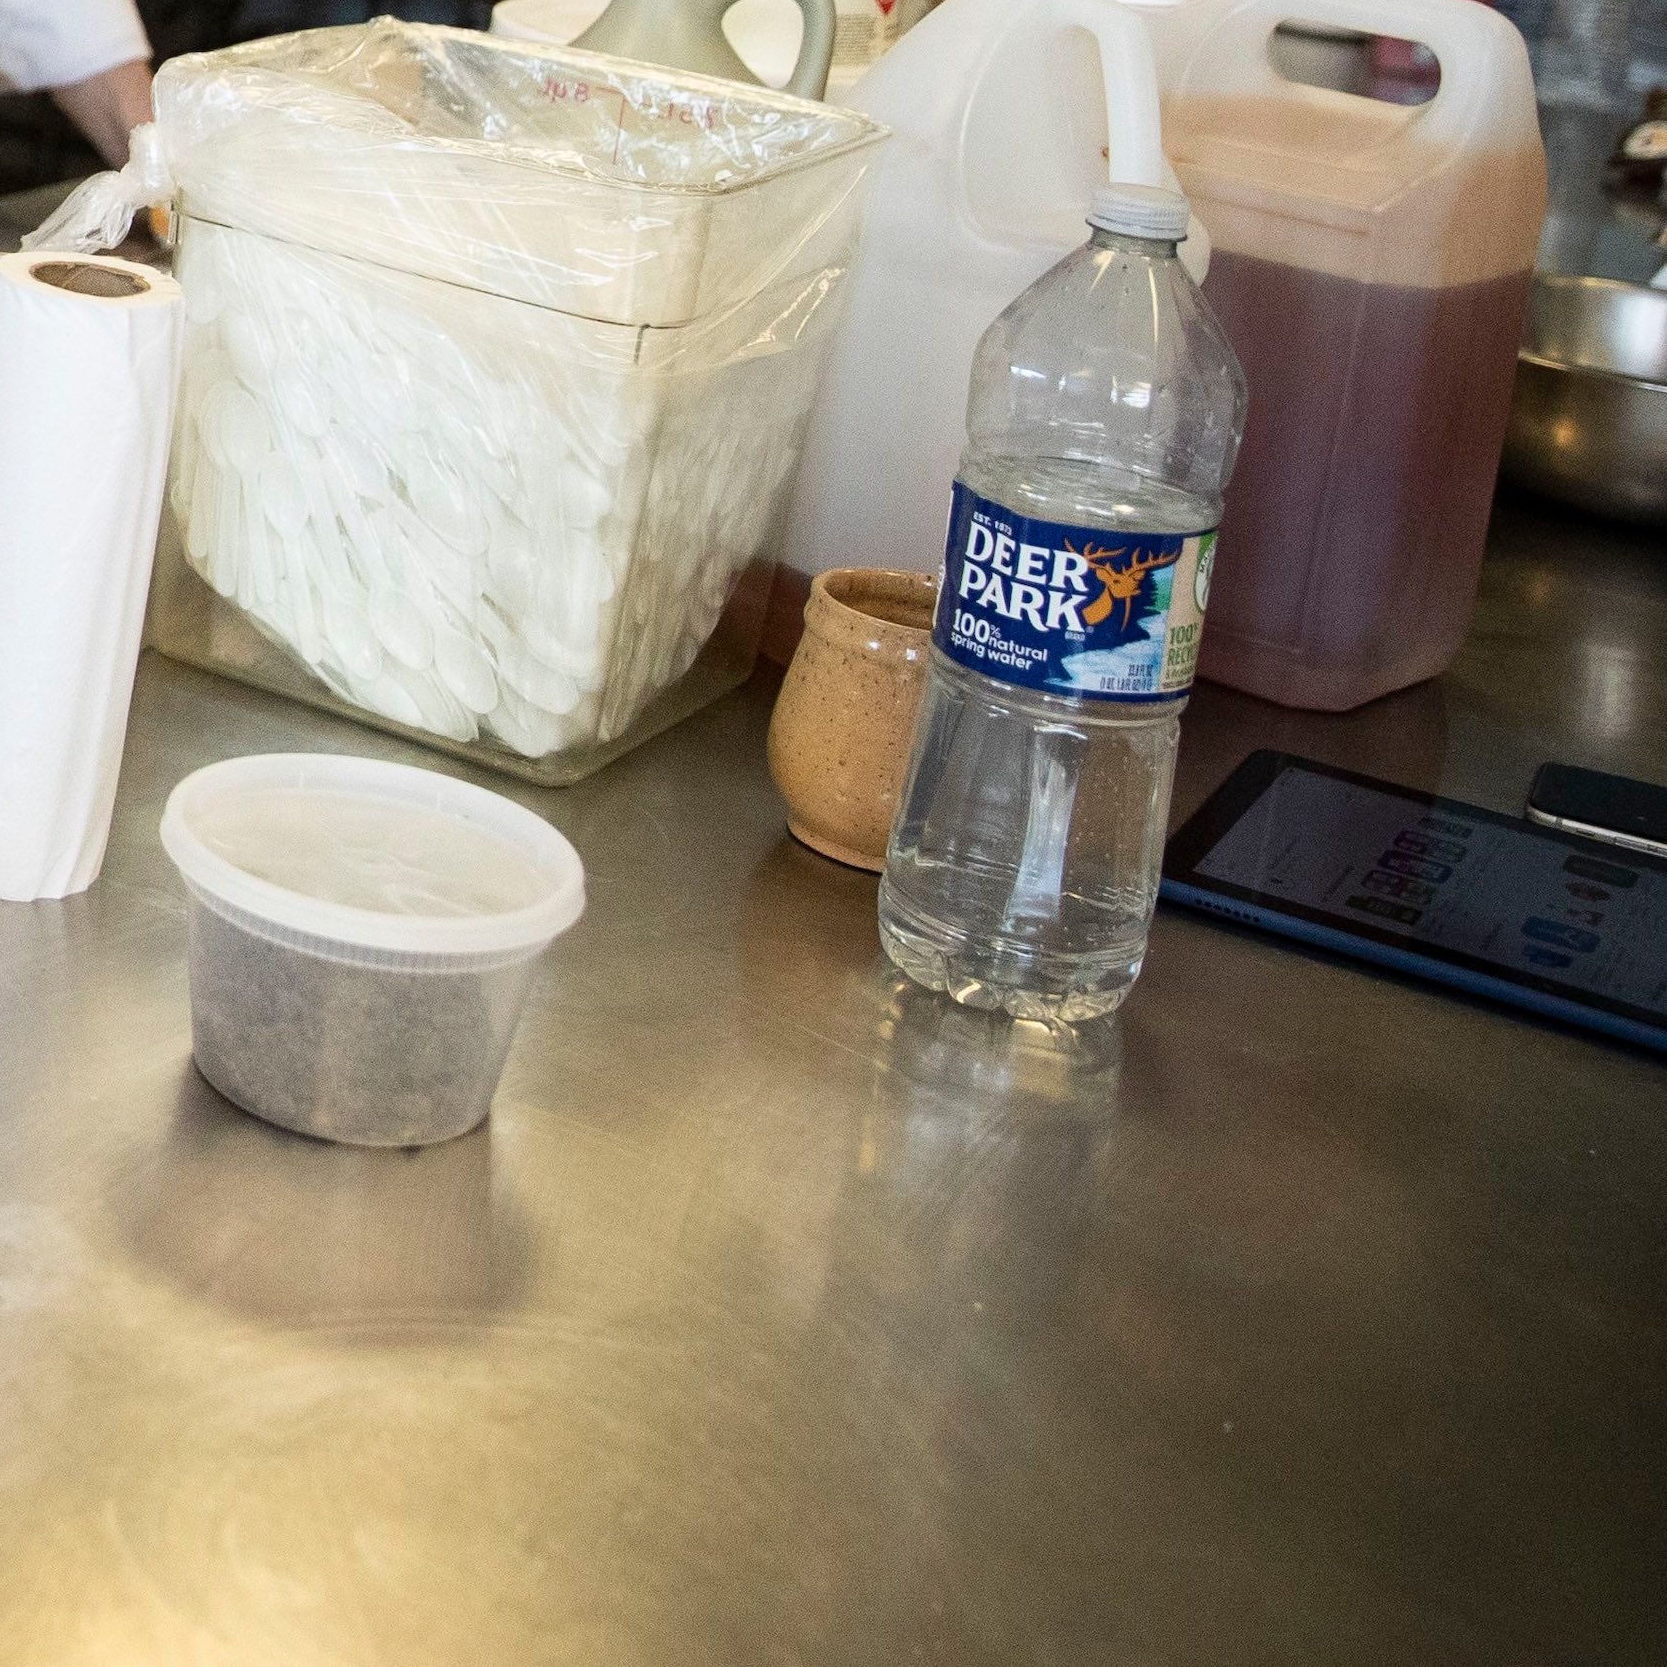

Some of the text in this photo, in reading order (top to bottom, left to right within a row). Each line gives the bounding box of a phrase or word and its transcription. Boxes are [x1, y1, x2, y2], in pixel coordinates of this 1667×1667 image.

[965, 520, 1089, 592] DEER
[959, 559, 1087, 633] PARK
[951, 632, 1033, 670] spring water
[953, 608, 1048, 662] 100% natural
